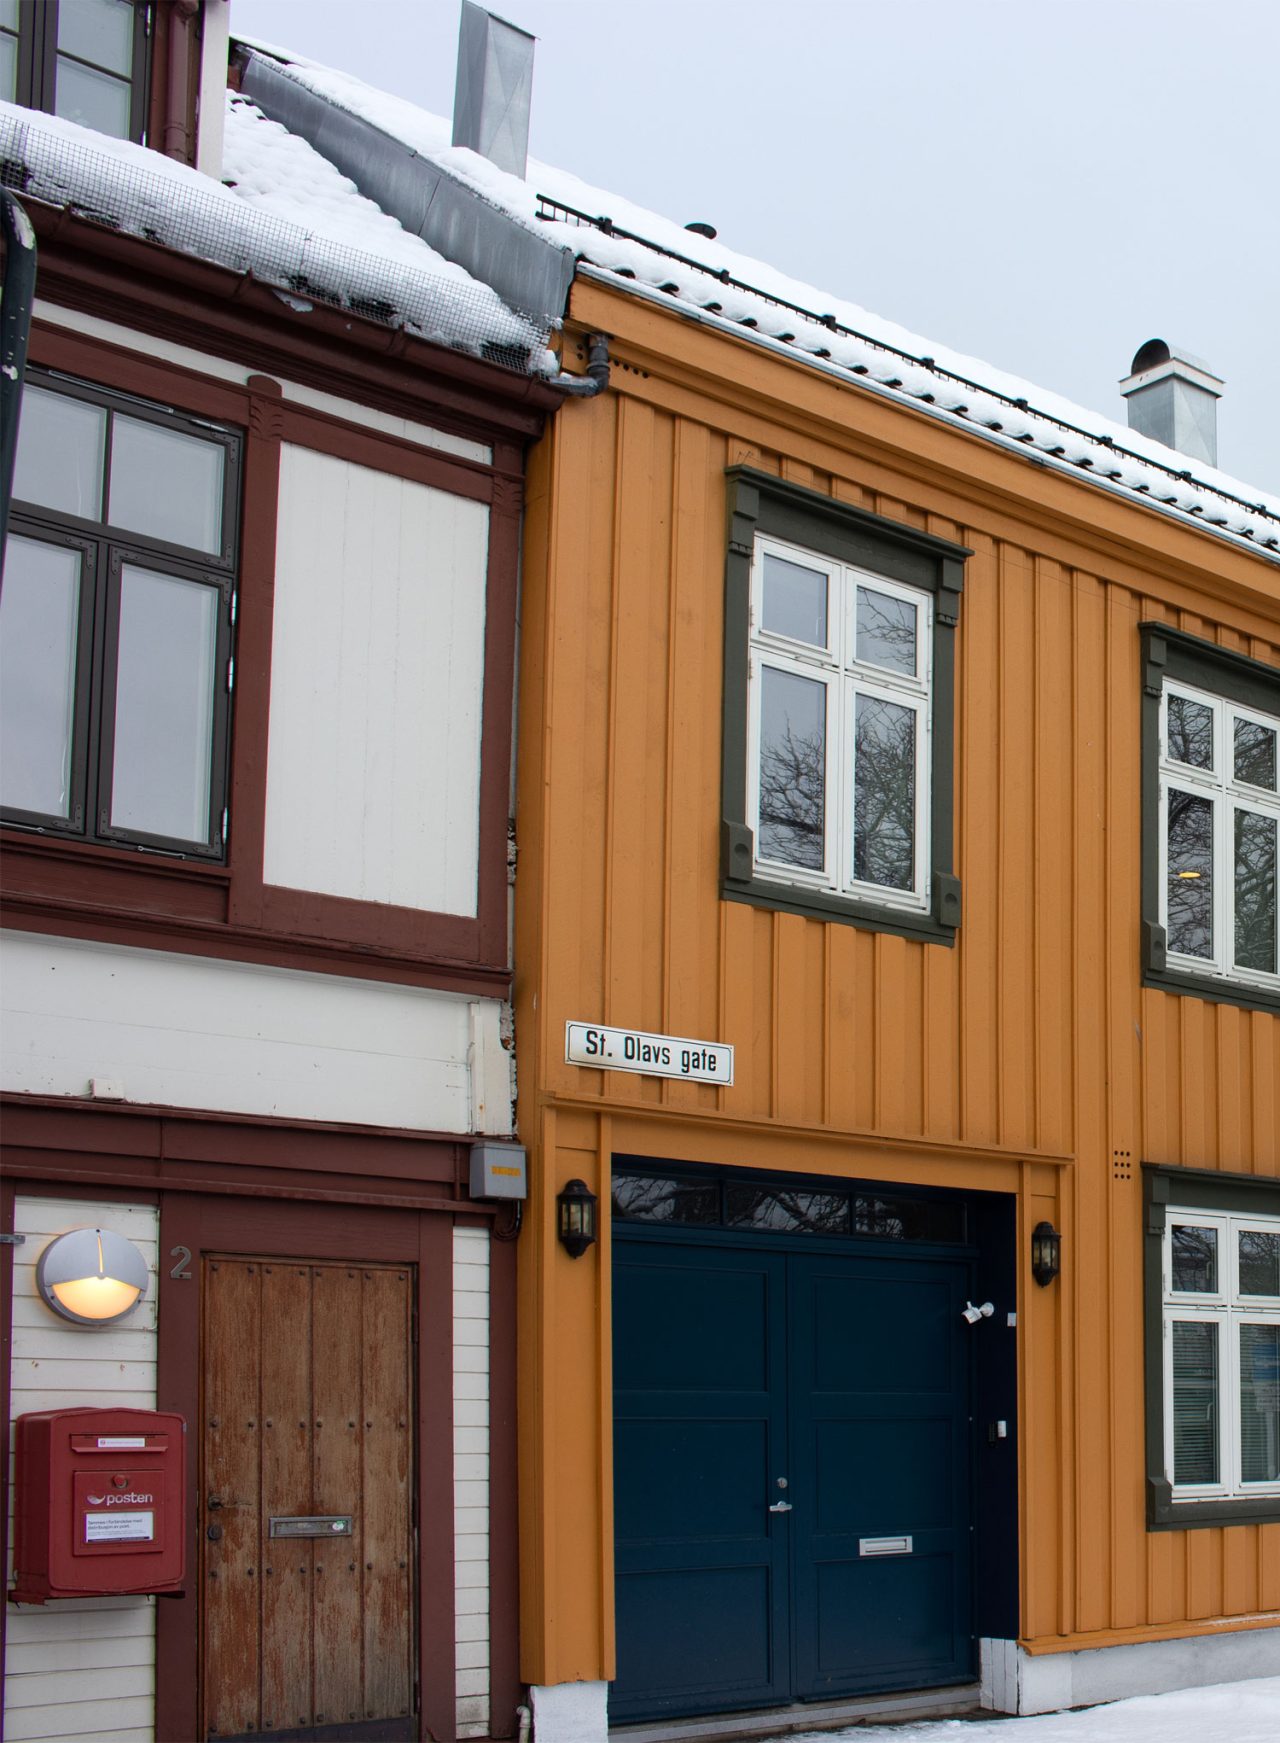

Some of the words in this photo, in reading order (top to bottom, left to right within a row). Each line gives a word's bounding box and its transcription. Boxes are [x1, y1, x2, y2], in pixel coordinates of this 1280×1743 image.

[585, 1030, 613, 1057] St.
[624, 1036, 671, 1065] Olavs
[681, 1048, 717, 1074] gate
[170, 1245, 192, 1279] 2
[106, 1492, 153, 1506] posten
